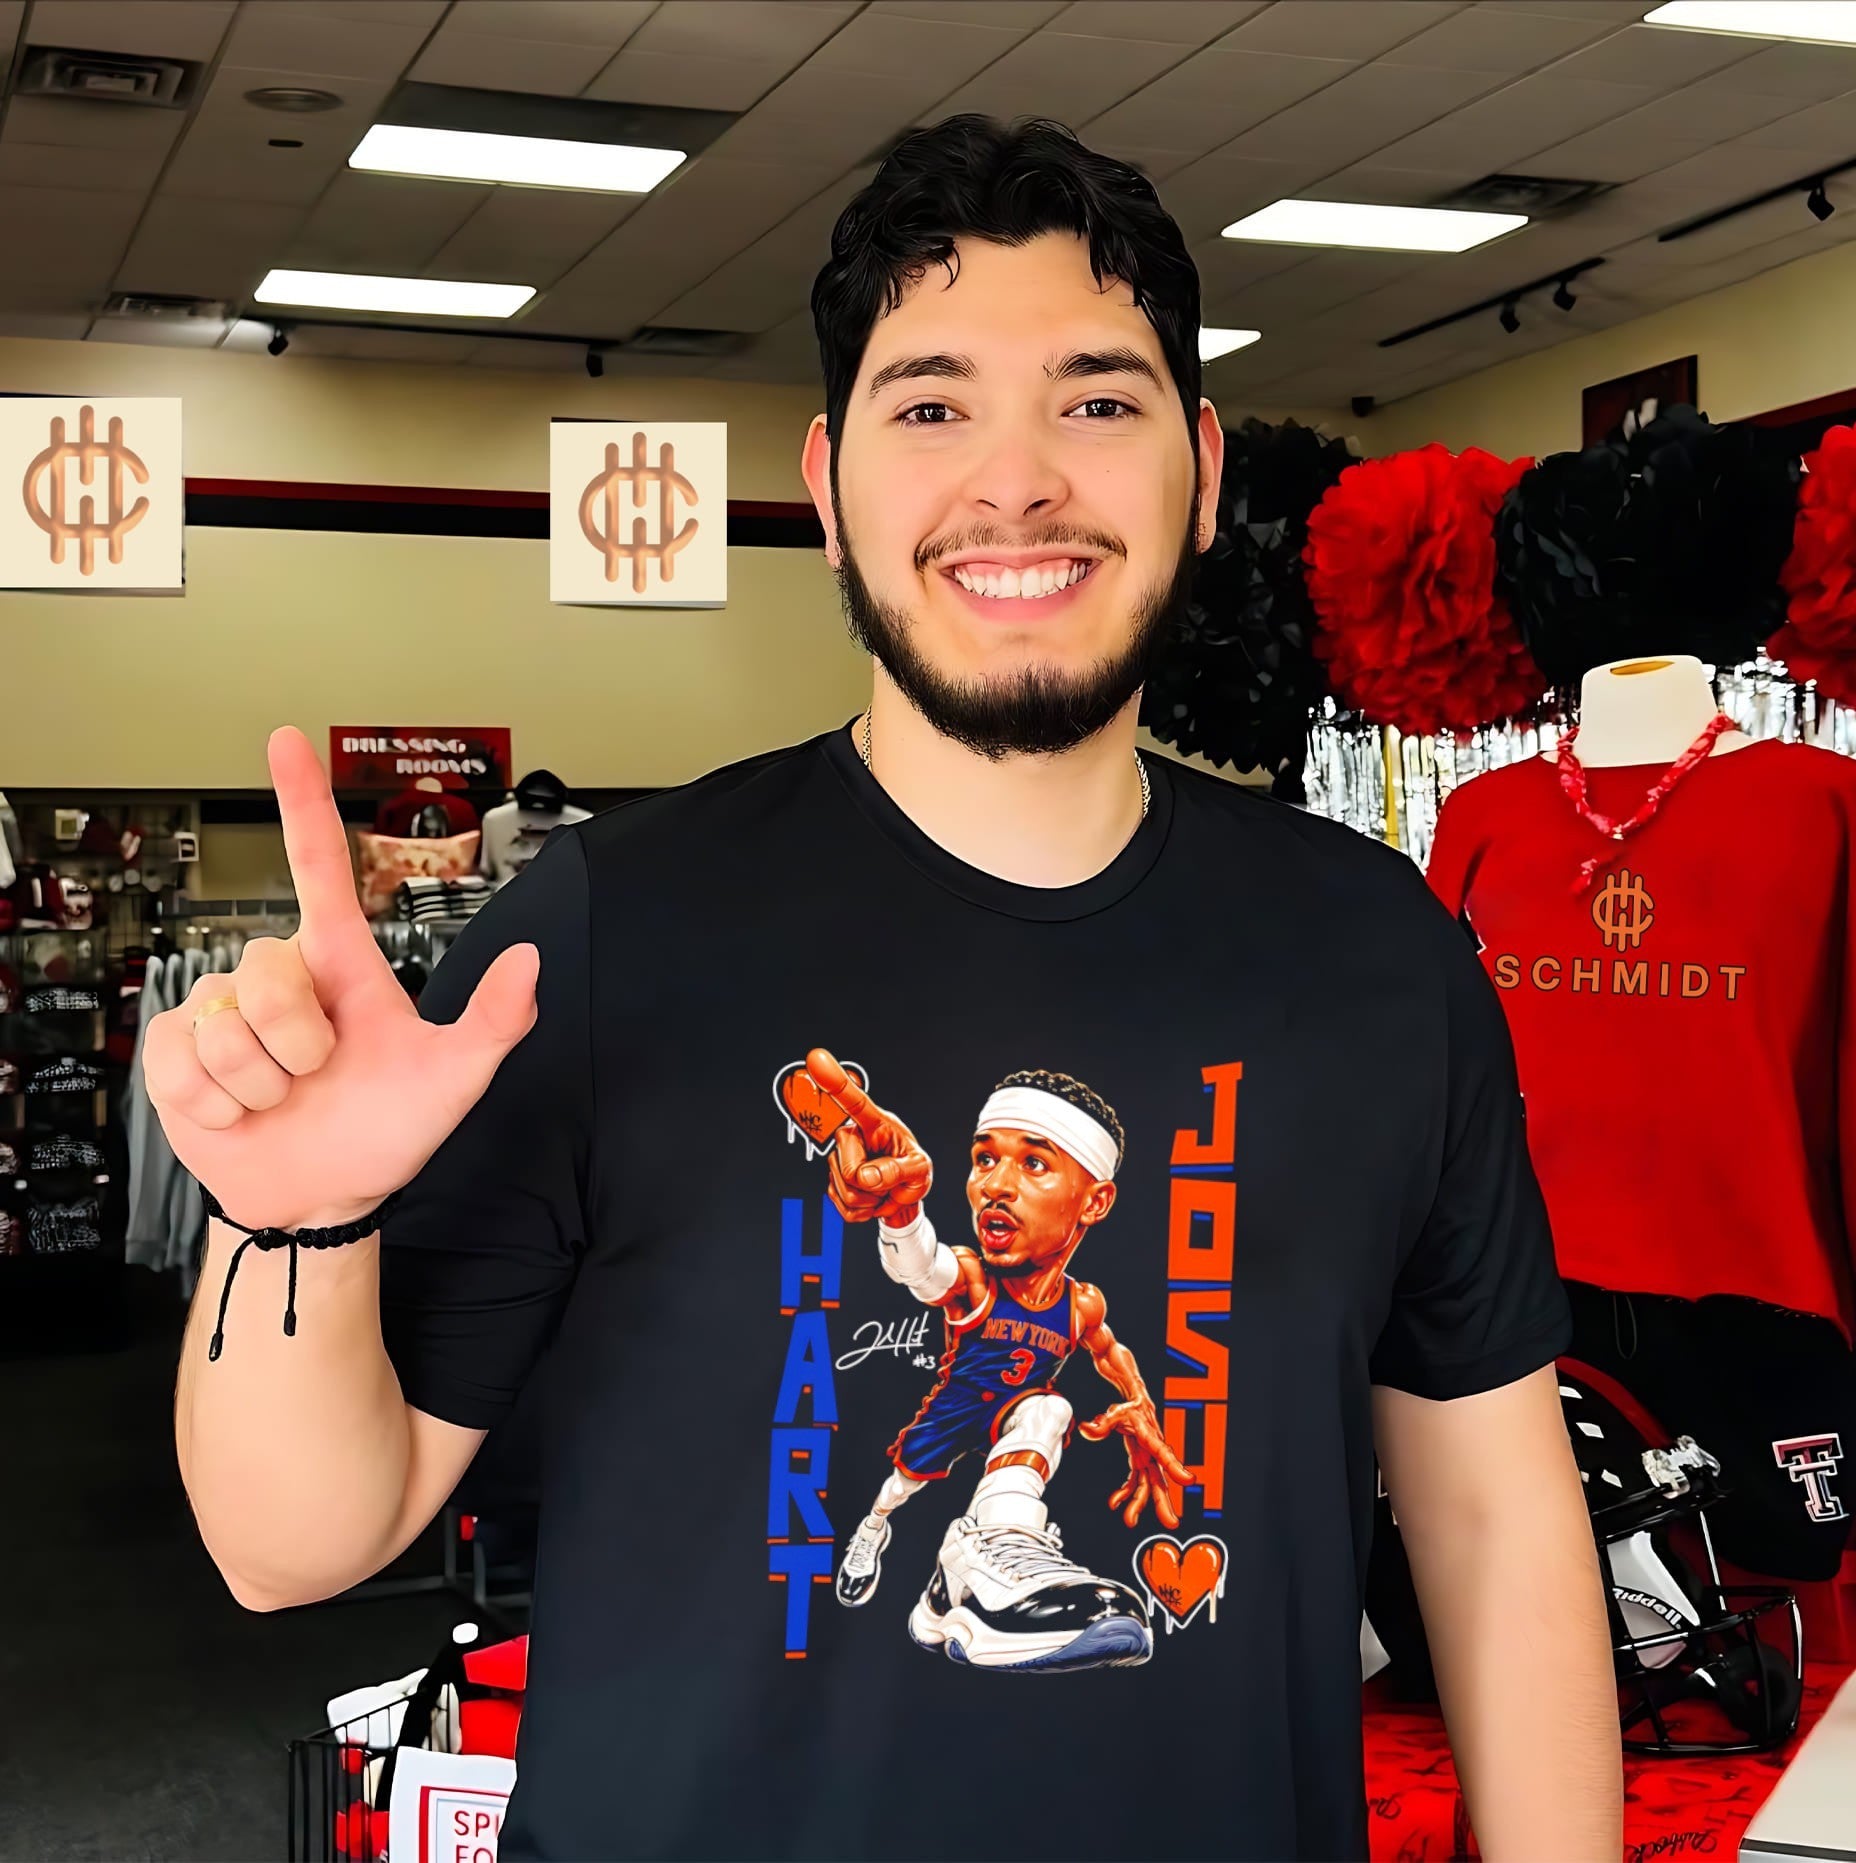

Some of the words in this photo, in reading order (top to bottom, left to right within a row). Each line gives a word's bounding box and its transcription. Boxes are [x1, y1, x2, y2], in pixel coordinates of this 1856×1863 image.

[396, 758, 487, 775] ROOMS
[1494, 953, 1747, 1000] SCHMIDT
[1164, 1061, 1244, 1517] JOSH
[981, 1317, 1029, 1342] NEW
[1028, 1324, 1070, 1359] YORK
[912, 1352, 936, 1369] #3
[1000, 1348, 1036, 1386] 3
[767, 1194, 844, 1659] HART
